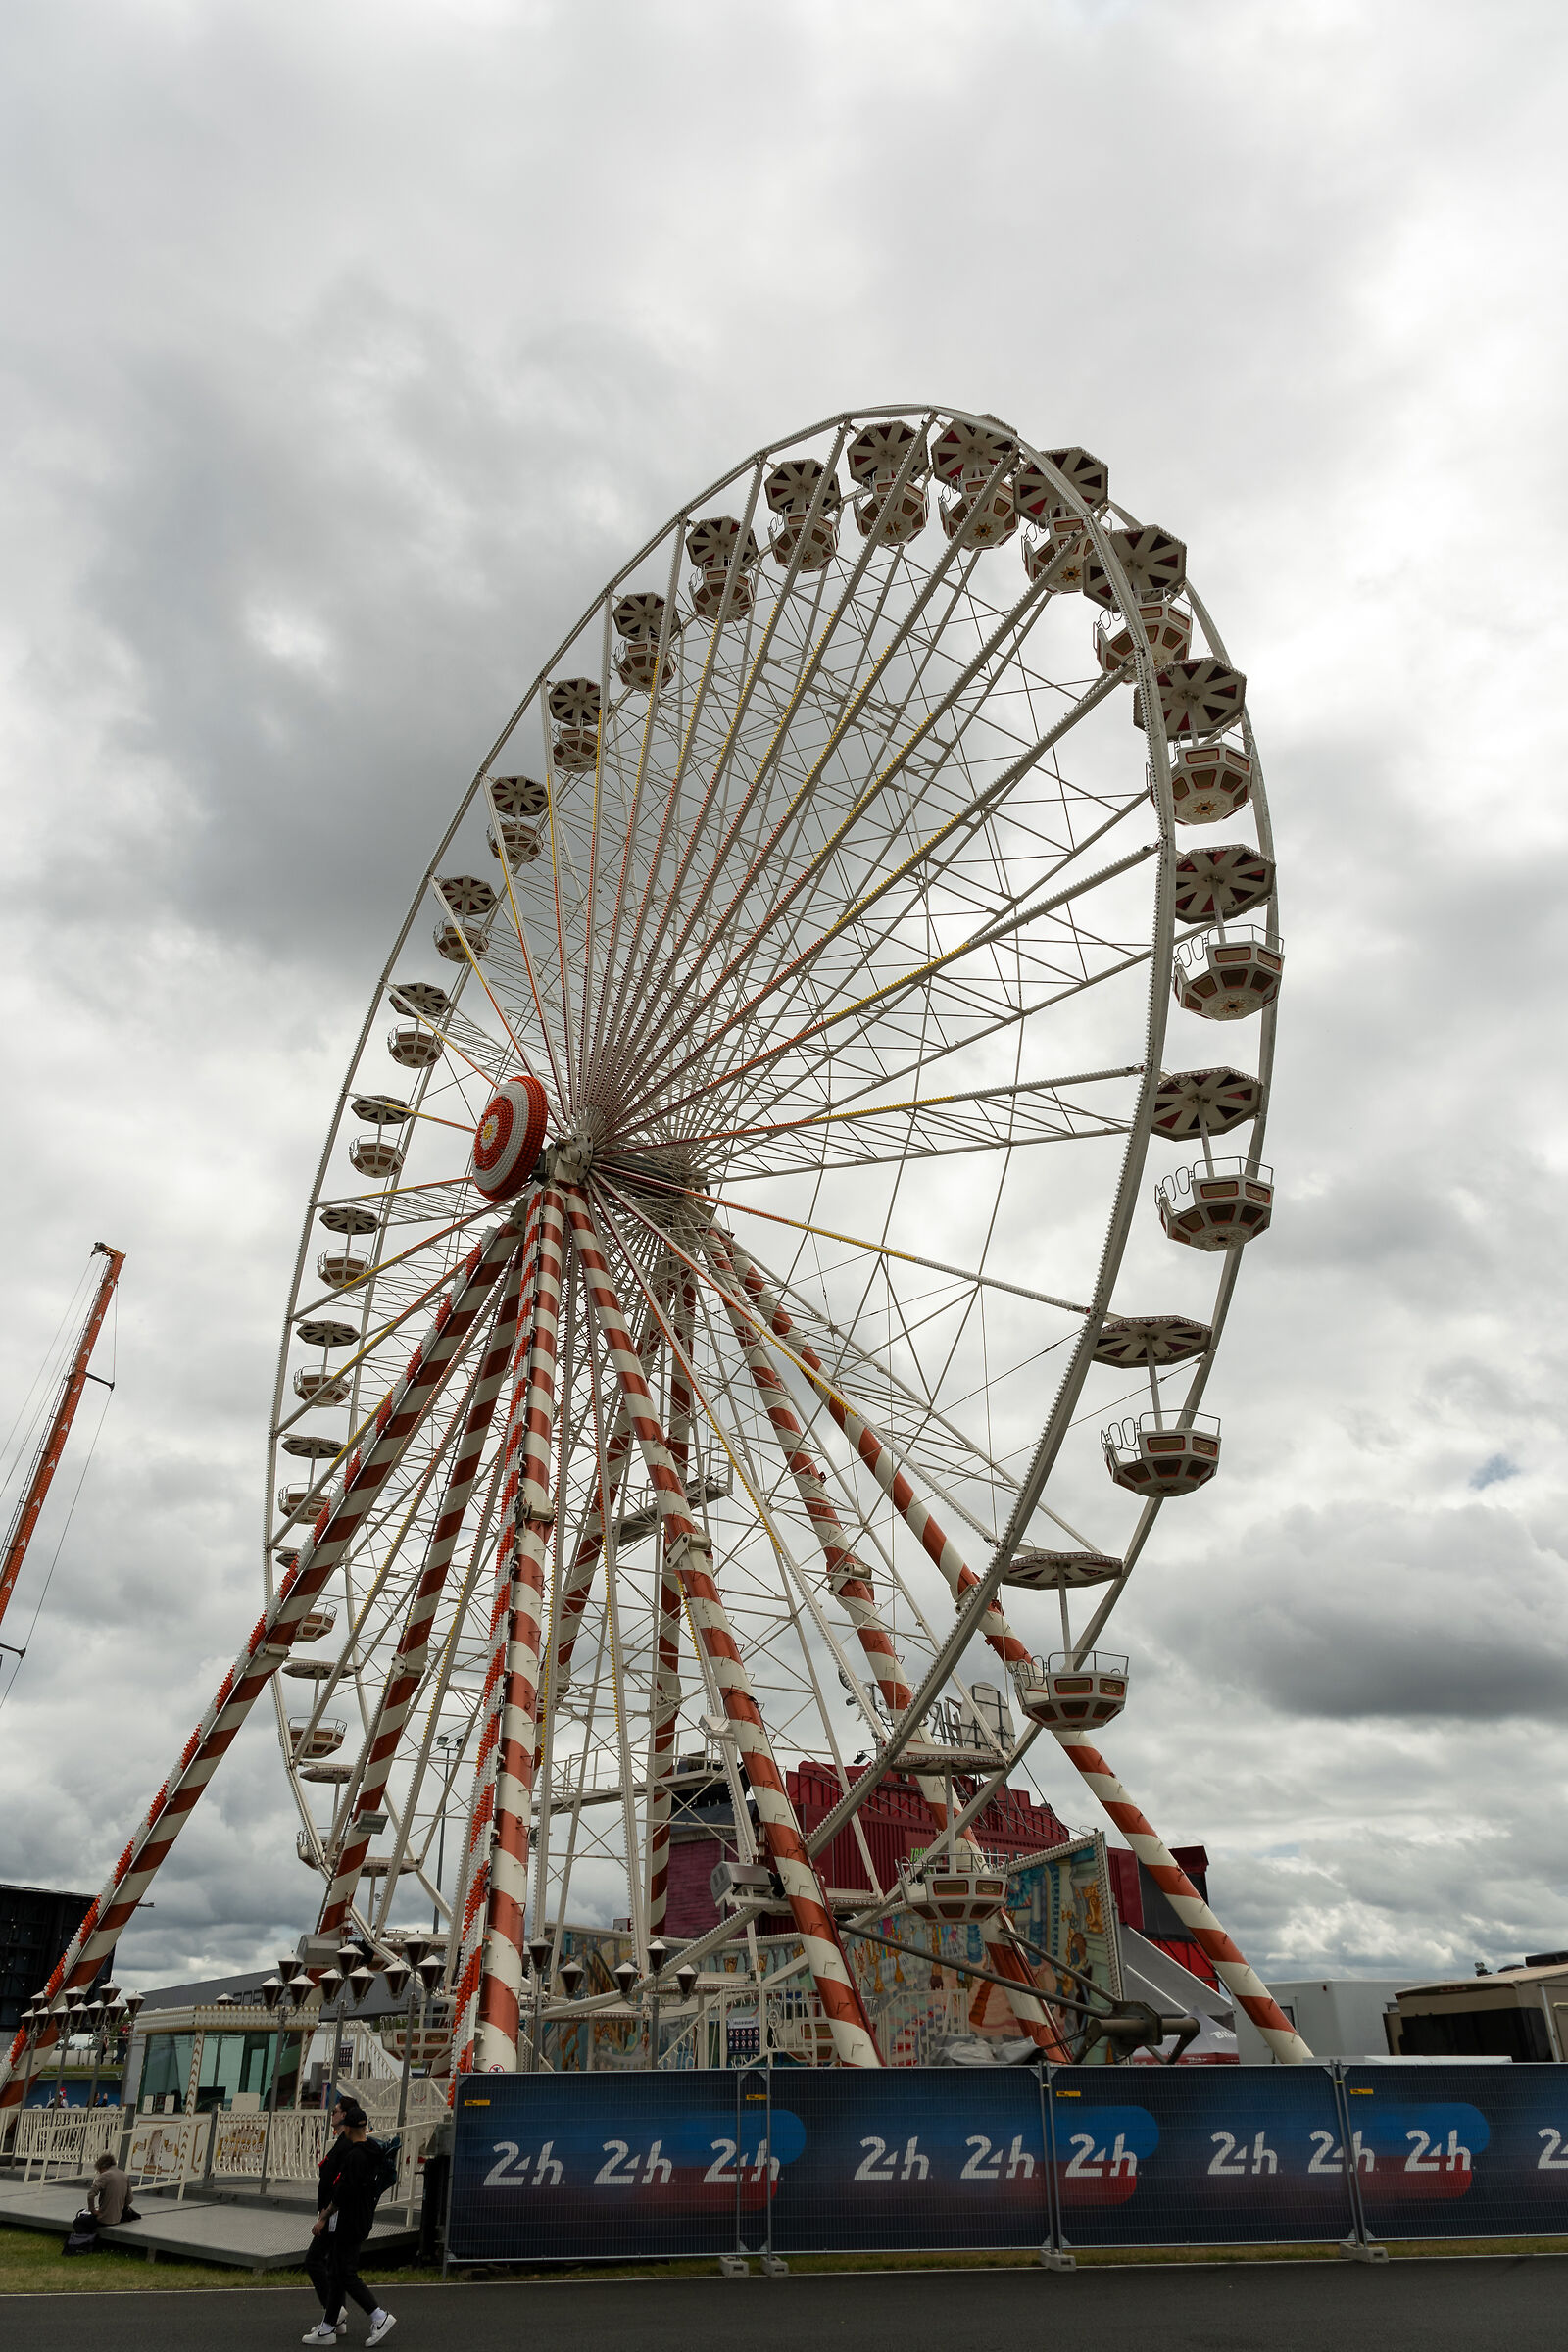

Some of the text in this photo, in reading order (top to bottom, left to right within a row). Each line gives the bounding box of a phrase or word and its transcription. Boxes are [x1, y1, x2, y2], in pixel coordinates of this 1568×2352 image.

[483, 2138, 780, 2186] 24h 24h 24h
[854, 2133, 1138, 2180] 24h 24h 24h
[1207, 2130, 1471, 2175] 24h 24h 24h
